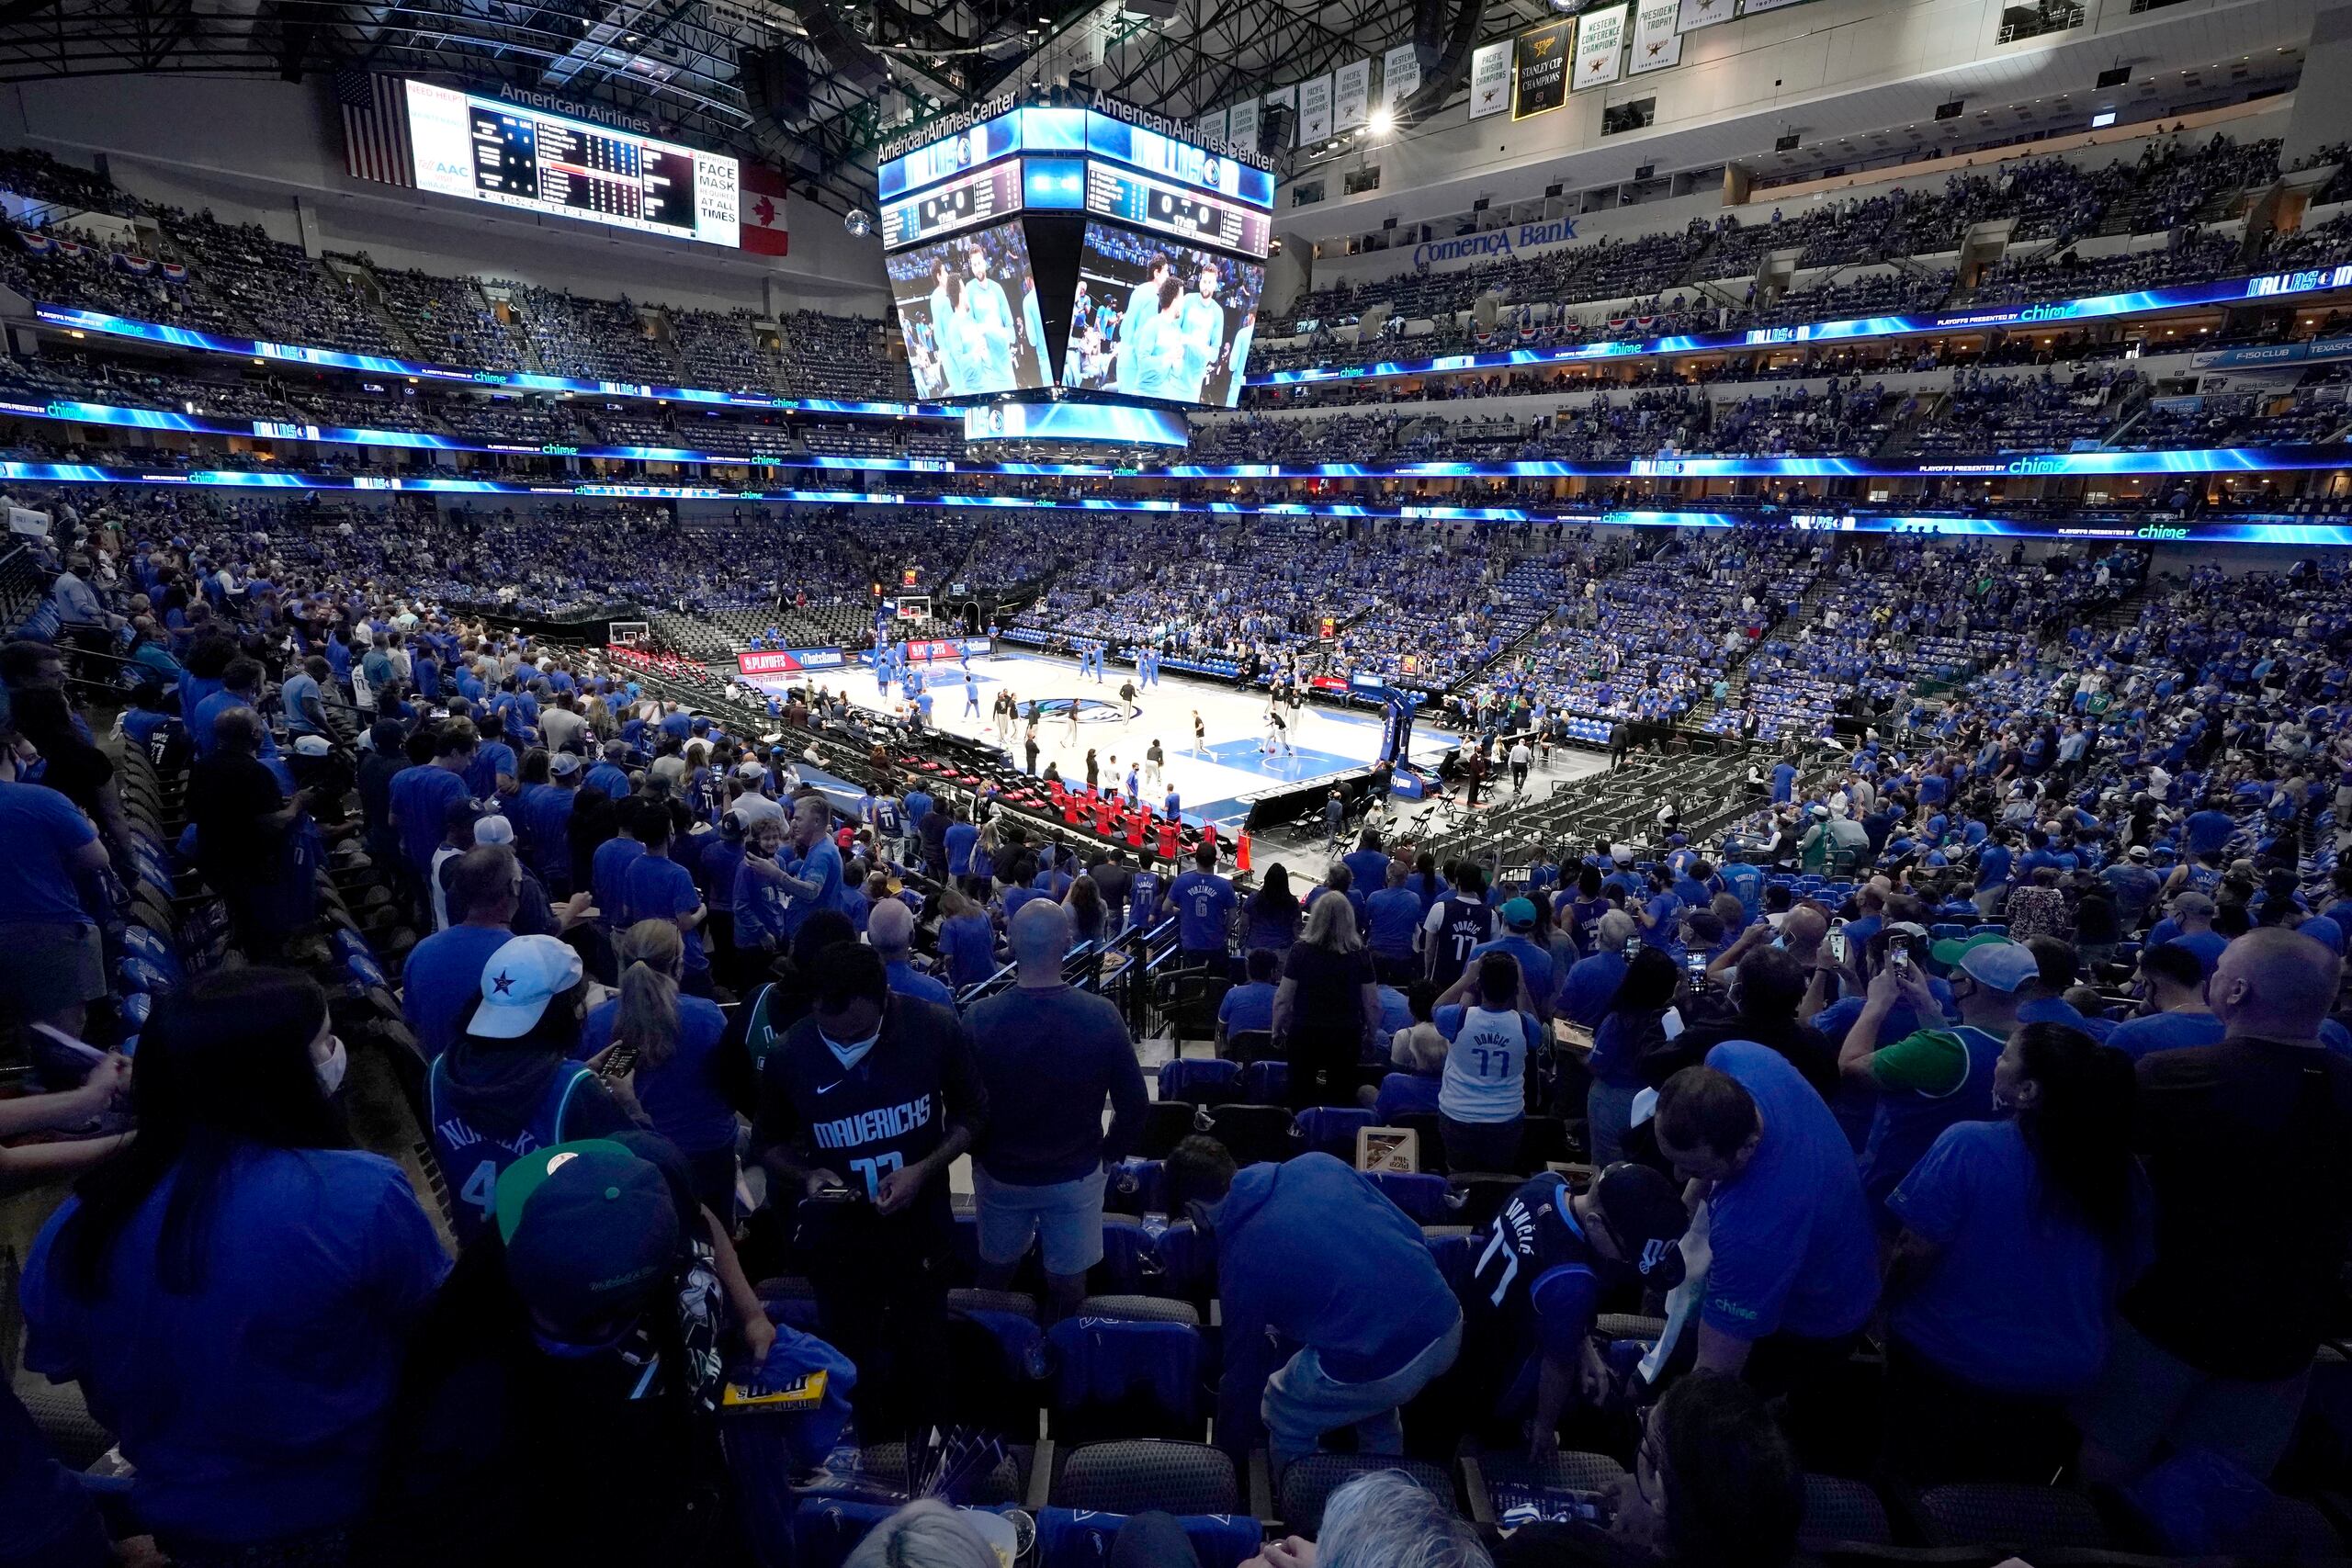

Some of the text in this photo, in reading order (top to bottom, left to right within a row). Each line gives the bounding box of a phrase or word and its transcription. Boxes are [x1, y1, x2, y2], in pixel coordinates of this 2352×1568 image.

[1588, 17, 1617, 32] WESTERN
[1647, 17, 1673, 30] TROPHY
[1532, 36, 1556, 49] STARS
[1581, 27, 1621, 45] CONFERENCE
[1581, 38, 1618, 55] CHAMPIONS
[1391, 52, 1416, 66] WESTERN
[1481, 51, 1503, 65] PACIFIC
[1386, 62, 1419, 77] CONFERENCE
[1480, 61, 1504, 75] DIVISION
[1521, 57, 1563, 79] STANLEY CUP
[1343, 70, 1361, 82] PACIFIC
[1387, 71, 1416, 86] CHAMPIONS
[1476, 71, 1507, 85] CHAMPIONS
[1521, 71, 1560, 92] CHAMPIONS
[1306, 85, 1324, 96] PACIFIC
[1341, 78, 1362, 91] DIVISION
[408, 85, 463, 103] NEED HELP?
[1306, 94, 1326, 106] DIVISION
[1338, 87, 1364, 102] CHAMPIONS
[500, 83, 650, 134] American Airlines
[1235, 107, 1253, 119] CENTRAL
[1303, 101, 1329, 117] CHAMPIONS
[1204, 119, 1221, 130] WESTERN
[1235, 117, 1252, 129] DIVISION
[1232, 124, 1255, 138] CHAMPIONS
[697, 153, 737, 167] APPROVED
[436, 163, 469, 176] AAC
[699, 163, 735, 179] FACE
[699, 175, 735, 192] MASK
[699, 188, 735, 201] REQUIRED
[701, 197, 734, 211] AT ALL
[927, 200, 936, 218] 0
[956, 191, 965, 209] 0
[1161, 196, 1209, 224] 0 0
[701, 208, 735, 223] TIMES
[1518, 217, 1579, 248] Bank
[2247, 271, 2319, 297] DALLAS
[1937, 318, 1968, 326] PLAYOFFS
[1969, 314, 2007, 323] PRESENTED
[2021, 304, 2077, 321] chime
[1747, 328, 1789, 344] DALLAS
[1609, 343, 1643, 355] chime
[2236, 349, 2290, 360] F-150 CLUB
[474, 371, 506, 384] chime
[1340, 367, 1365, 378] chime
[772, 398, 798, 409] chime
[253, 421, 297, 439] DALLAS
[542, 444, 578, 456] chime
[752, 456, 781, 466] chime
[1630, 461, 1674, 476] DALLAS
[2009, 457, 2065, 474] chime
[1114, 467, 1138, 476] chime
[740, 491, 763, 500] chime
[1035, 500, 1057, 508] chime
[2138, 524, 2187, 539] chime
[752, 655, 786, 669] PLAYOFFS
[880, 813, 894, 828] 77
[1195, 896, 1208, 917] 6
[1453, 919, 1483, 935] DONČIĆ
[1474, 1032, 1511, 1048] DONČIĆ
[1472, 1048, 1510, 1078] 77
[813, 1093, 931, 1149] MAVERICKS
[1474, 1214, 1519, 1308] 77
[1714, 1297, 1758, 1321] chime
